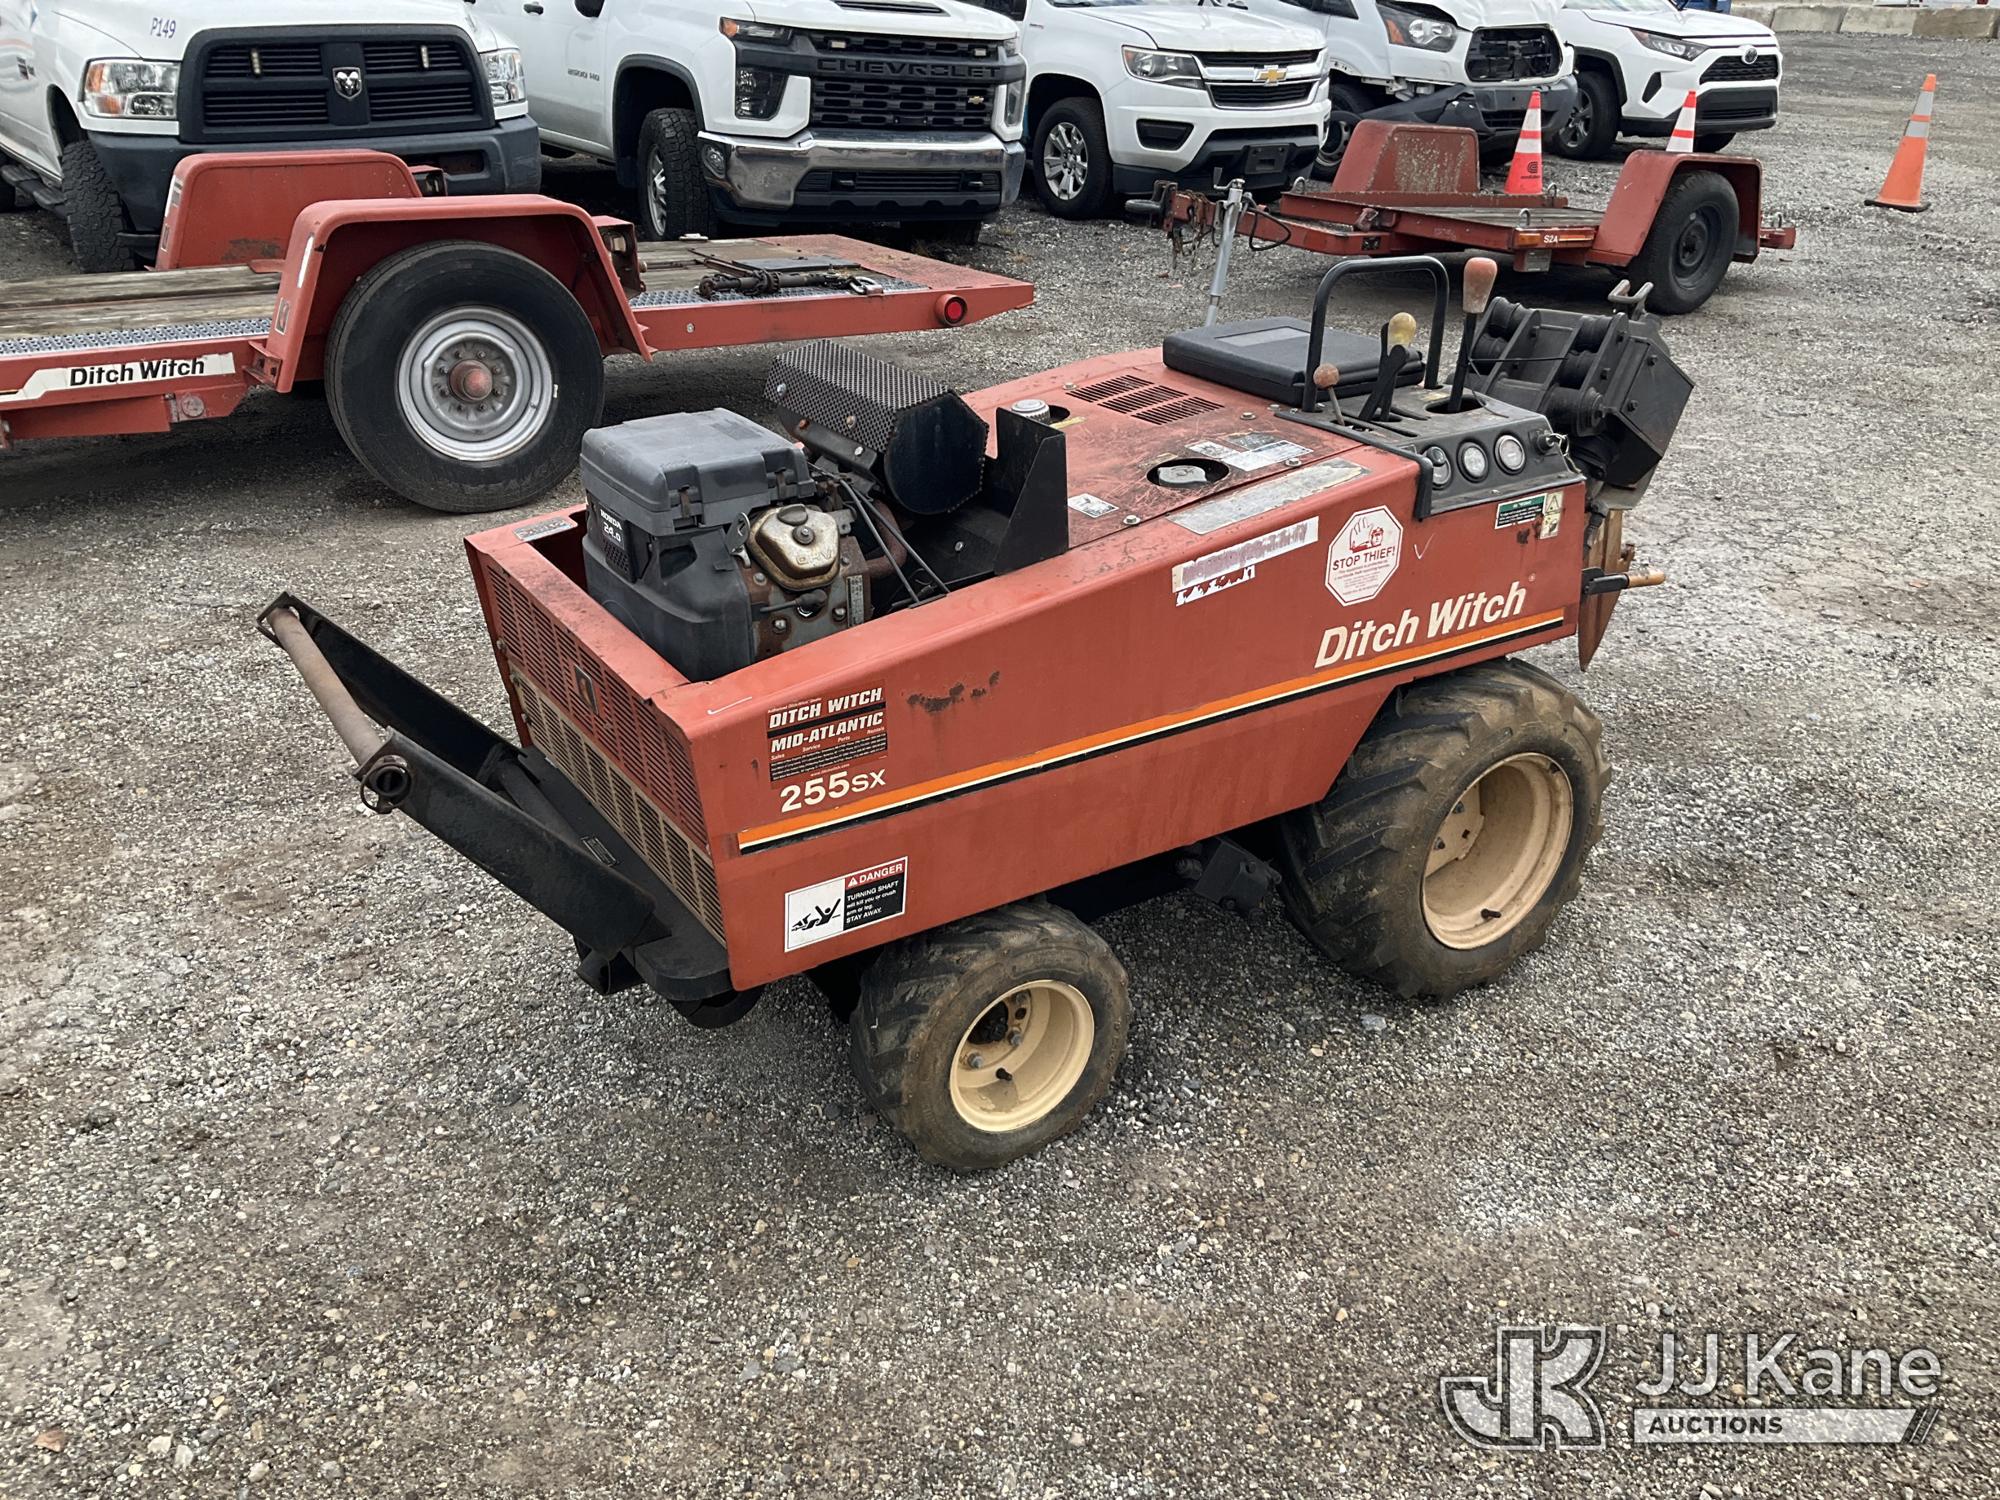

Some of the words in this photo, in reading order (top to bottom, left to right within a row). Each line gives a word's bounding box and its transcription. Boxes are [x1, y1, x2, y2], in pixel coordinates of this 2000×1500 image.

[150, 17, 176, 39] P149
[817, 58, 1000, 78] CHEVROLET
[70, 364, 133, 386] Ditch
[140, 357, 205, 379] Witch
[600, 509, 622, 531] HONDA
[1332, 555, 1361, 571] STOP
[1363, 546, 1396, 562] THIEF!
[1314, 608, 1420, 669] Ditch
[1427, 581, 1527, 638] Witch
[769, 703, 821, 728] DITCH
[828, 687, 882, 713] WITCH
[771, 712, 884, 753] MID-ATLANTIC
[859, 863, 903, 883] DANGER
[847, 887, 877, 901] TURNING
[878, 880, 899, 892] SHAFT
[881, 889, 897, 898] crush
[846, 914, 862, 924] STAY
